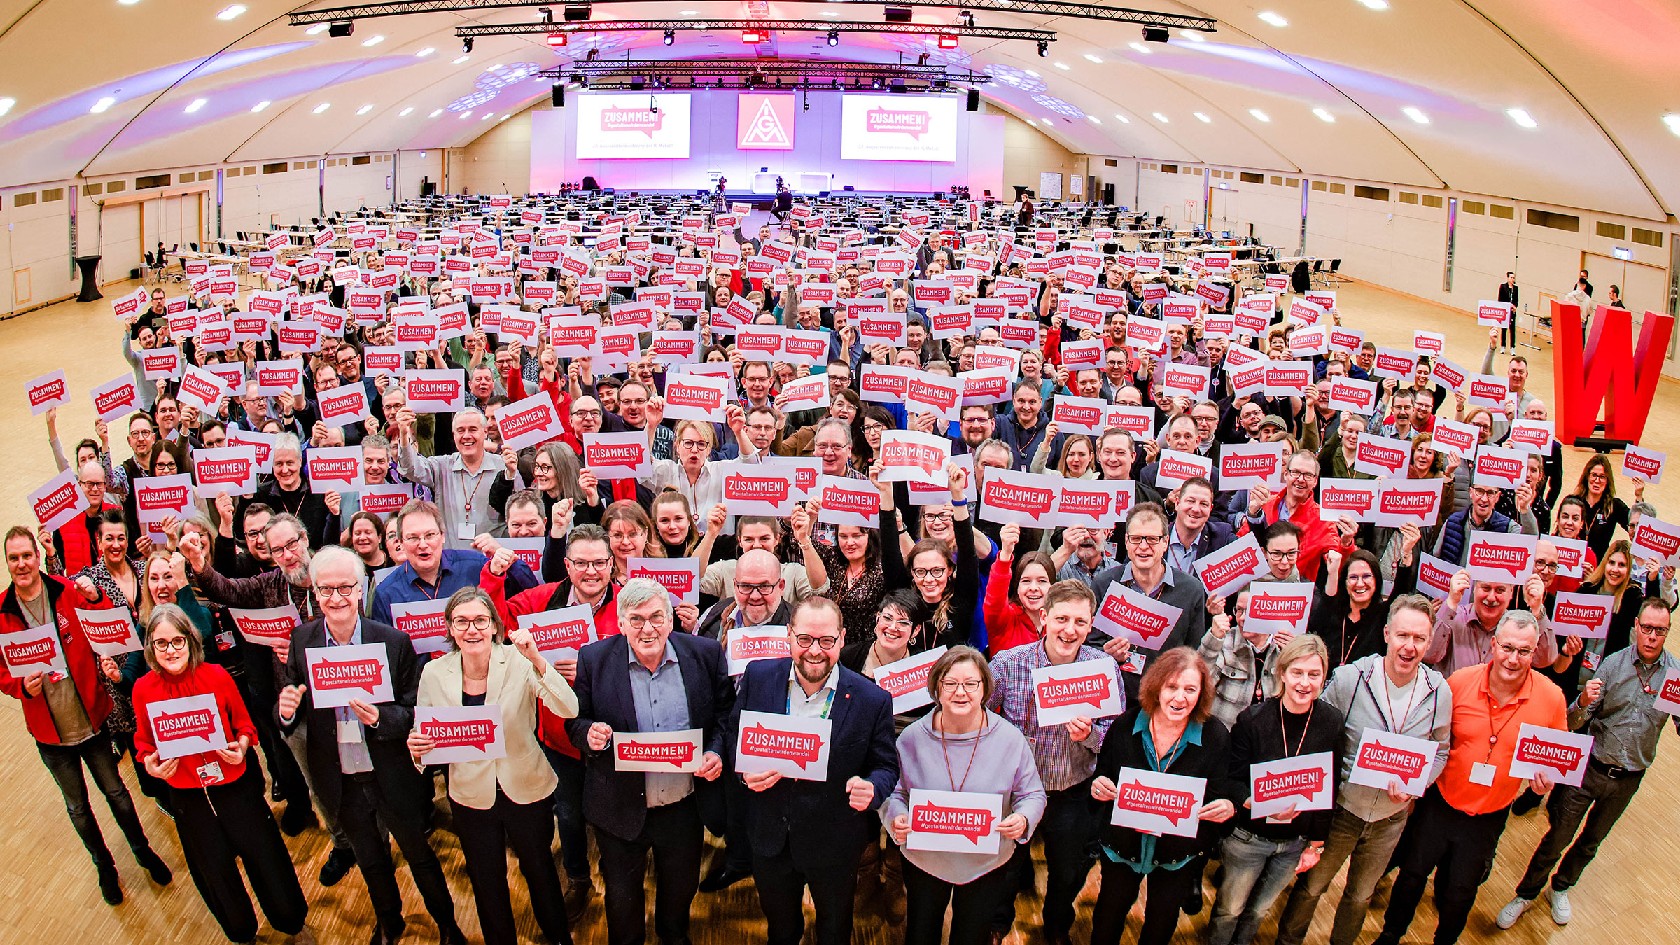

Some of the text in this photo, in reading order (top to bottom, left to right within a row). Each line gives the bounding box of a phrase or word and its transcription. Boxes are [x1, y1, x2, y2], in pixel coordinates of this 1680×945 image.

[870, 113, 925, 125] ZUSAMMEN!
[553, 329, 592, 339] ZUSAMMEN!
[788, 340, 822, 349] ZUSAMMEN!
[261, 371, 296, 380] ZUSAMMEN!
[866, 377, 905, 386] ZUSAMMEN!
[1168, 374, 1202, 385] ZUSAMMEN!
[411, 383, 455, 392] ZUSAMMEN!
[671, 388, 718, 400] ZUSAMMEN!
[911, 384, 953, 400] ZUSAMMEN!
[1334, 387, 1368, 399] ZUSAMMEN!
[97, 386, 131, 408] ZUSAMMEN!
[323, 395, 360, 411] ZUSAMMEN!
[502, 408, 546, 432] ZUSAMMEN!
[1058, 408, 1097, 418] ZUSAMMEN!
[1110, 416, 1146, 425] ZUSAMMEN!
[1437, 429, 1470, 443] ZUSAMMEN!
[589, 447, 639, 458] ZUSAMMEN!
[886, 447, 939, 461] ZUSAMMEN!
[1361, 446, 1401, 462] ZUSAMMEN!
[200, 462, 246, 475] ZUSAMMEN!
[312, 461, 354, 472] ZUSAMMEN!
[1164, 462, 1203, 476] ZUSAMMEN!
[1226, 458, 1272, 469] ZUSAMMEN!
[1481, 459, 1519, 471] ZUSAMMEN!
[729, 481, 784, 492] ZUSAMMEN!
[36, 486, 73, 516] ZUSAMMEN!
[141, 489, 184, 502] ZUSAMMEN!
[365, 496, 404, 506] ZUSAMMEN!
[826, 492, 876, 506] ZUSAMMEN!
[989, 486, 1048, 504] ZUSAMMEN!
[1325, 493, 1369, 502] ZUSAMMEN!
[1384, 495, 1432, 505] ZUSAMMEN!
[1639, 529, 1677, 549] ZUSAMMEN!
[1474, 548, 1524, 561] ZUSAMMEN!
[1204, 551, 1253, 583] ZUSAMMEN!
[1254, 600, 1303, 610] ZUSAMMEN!
[1107, 600, 1163, 630] ZUSAMMEN!
[1558, 607, 1602, 618] ZUSAMMEN!
[242, 620, 291, 630] ZUSAMMEN!
[400, 616, 445, 631] ZUSAMME
[532, 624, 583, 642] USAMMEN!
[7, 642, 52, 659] ZUSAMMEN!
[736, 640, 790, 651] ZUSAMMEN
[315, 664, 377, 679] ZUSAMMEN!
[884, 666, 932, 690] ZUSAMME
[1041, 678, 1104, 698] ZUSAMMEN!
[157, 713, 210, 732] ZUSAMMEN!
[424, 724, 489, 738] ZUSAMMEN!
[746, 732, 815, 751] ZUSAMMEN!
[1363, 747, 1421, 768] ZUSAMMEN!
[1522, 742, 1577, 761] ZUSAMMEN!
[1258, 771, 1318, 792] ZUSAMMEN!
[1123, 788, 1189, 808] ZUSAMMEN!
[917, 810, 986, 825] ZUSAMMEN!
